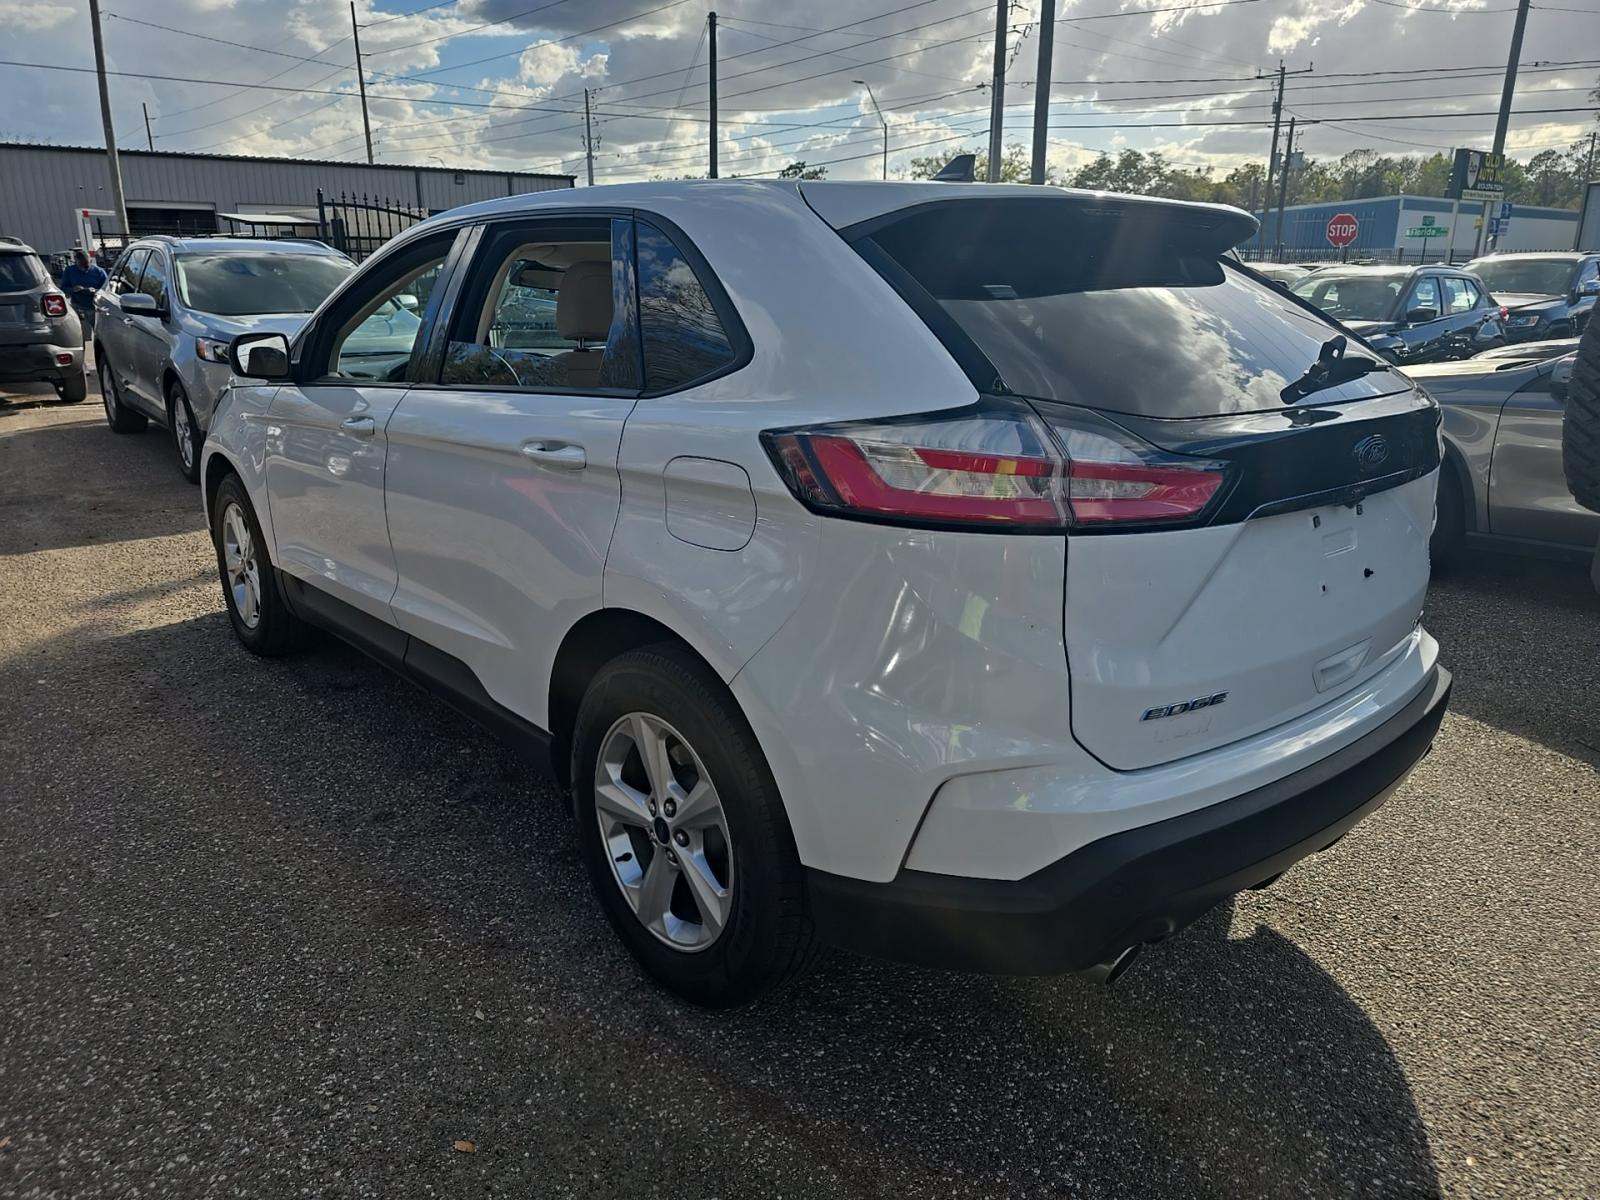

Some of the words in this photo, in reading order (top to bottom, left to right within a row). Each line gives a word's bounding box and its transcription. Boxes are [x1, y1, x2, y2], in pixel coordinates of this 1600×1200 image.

[1329, 224, 1356, 237] STOP
[1410, 226, 1436, 236] Florida
[1139, 689, 1230, 721] EDGE
